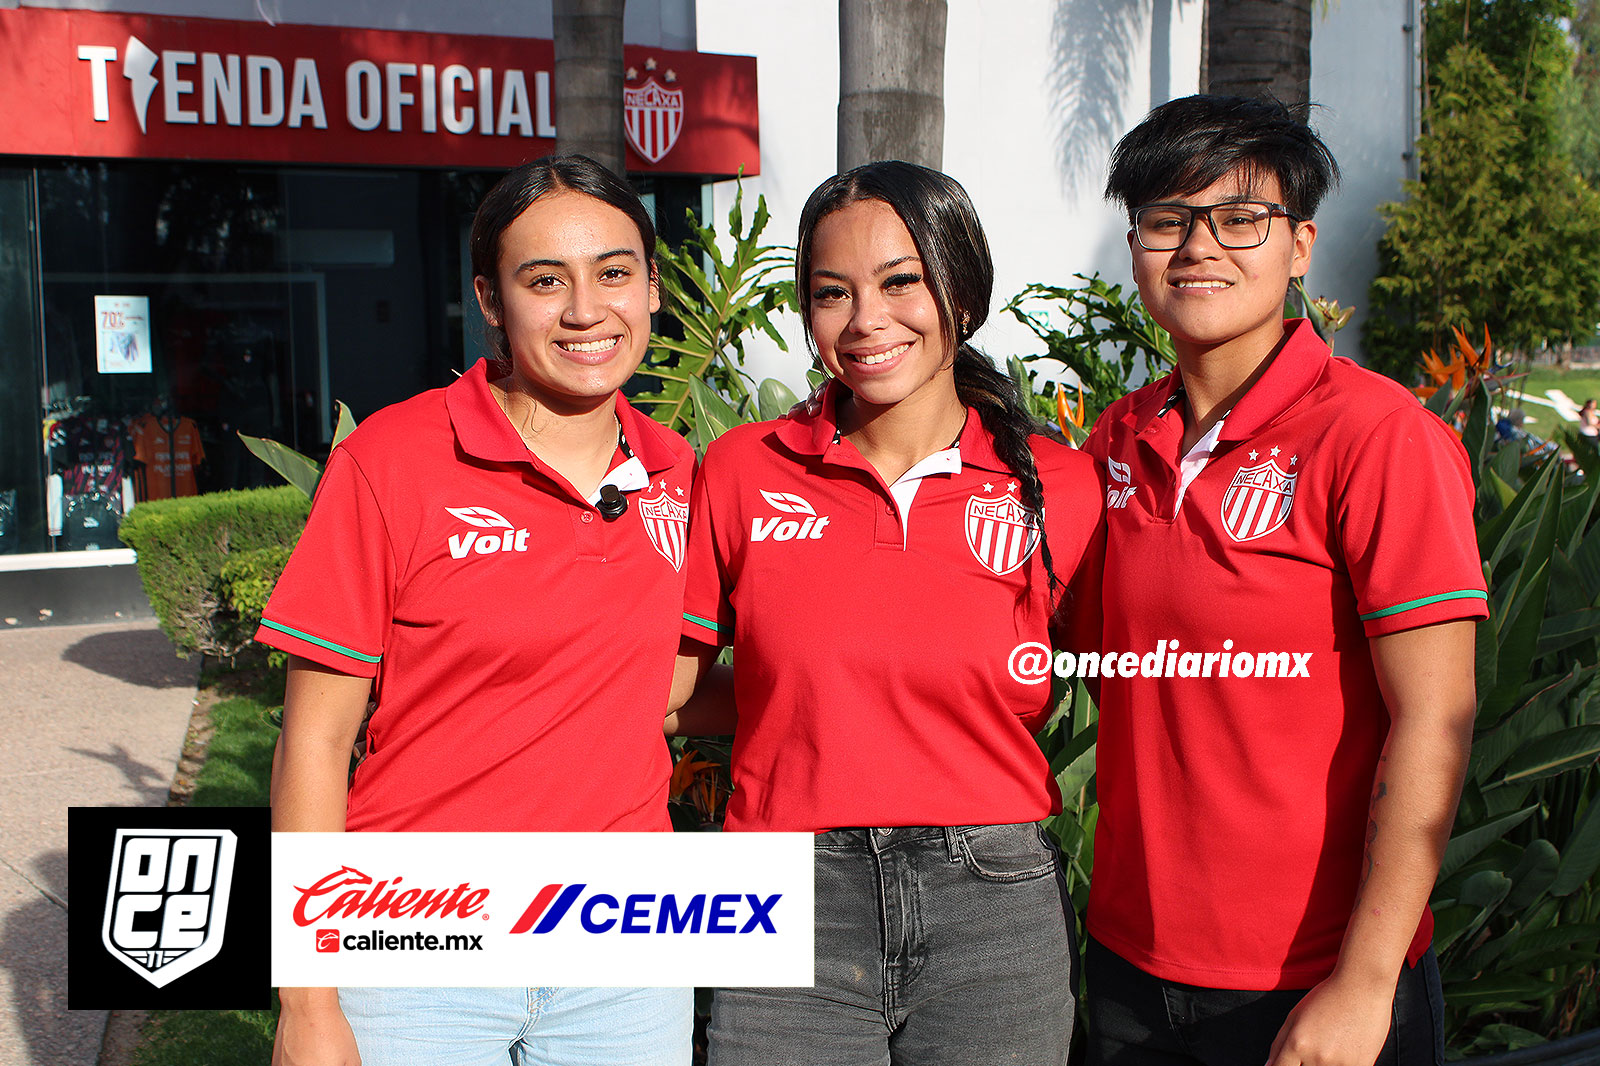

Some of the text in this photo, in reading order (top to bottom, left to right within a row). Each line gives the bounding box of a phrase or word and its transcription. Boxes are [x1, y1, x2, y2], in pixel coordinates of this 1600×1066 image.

[346, 60, 556, 138] OFICIAL
[625, 88, 680, 108] NECAXA
[1236, 468, 1293, 495] NECAXA
[1106, 484, 1138, 509] oit
[644, 502, 688, 521] NECAXA
[973, 502, 1036, 526] NECAXA
[750, 515, 831, 542] Voit
[447, 527, 531, 560] Voit
